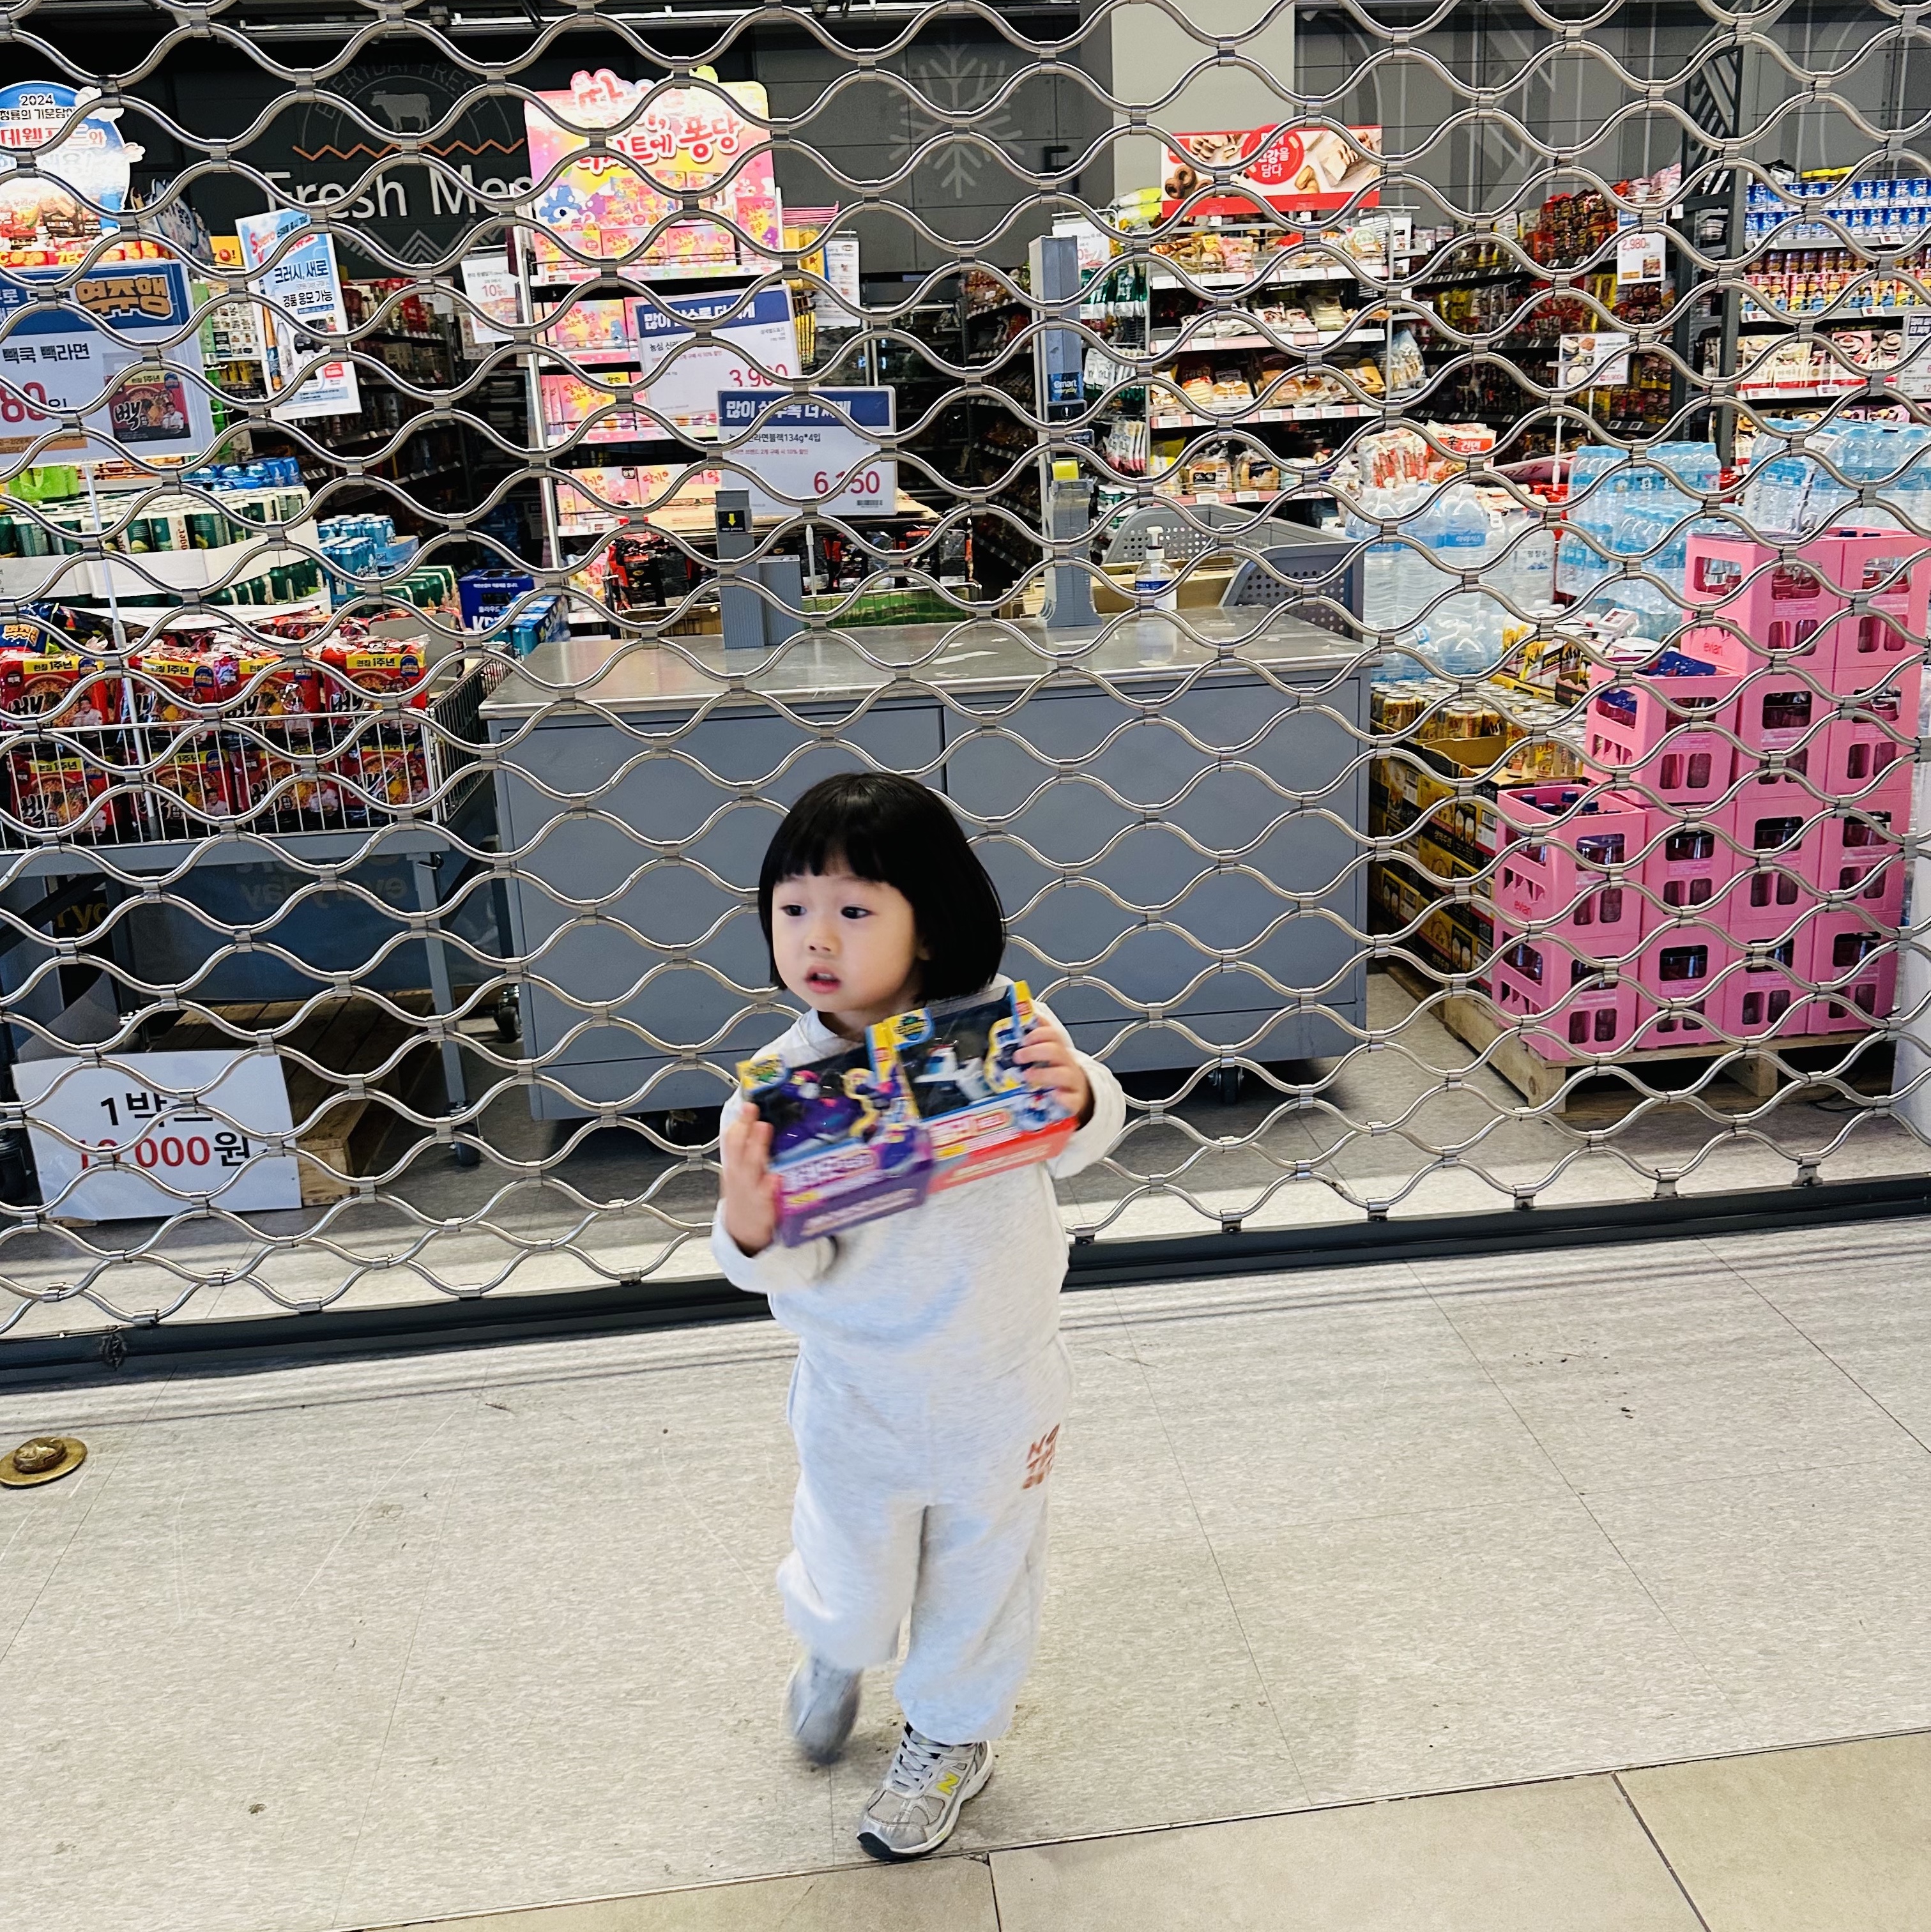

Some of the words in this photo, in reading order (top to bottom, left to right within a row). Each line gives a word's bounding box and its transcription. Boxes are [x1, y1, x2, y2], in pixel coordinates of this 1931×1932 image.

[21, 95, 54, 106] 2024
[678, 109, 740, 158] 퐁당
[1261, 164, 1283, 178] 담다
[264, 171, 408, 218] Fresh
[274, 264, 305, 284] 크러시,
[306, 259, 329, 278] 새로
[75, 277, 172, 317] 역주행
[283, 294, 297, 308] 경품
[298, 292, 314, 306] 응모
[316, 289, 333, 302] 가능
[644, 312, 671, 330] 많이
[40, 342, 90, 362] 빽라면
[726, 400, 755, 419] 많이
[813, 470, 880, 495] 6150
[49, 660, 73, 670] 1주년
[167, 664, 189, 675] 1주년
[372, 657, 395, 667] 1주년
[100, 1092, 214, 1128] 1박
[80, 1131, 251, 1170] 1000원
